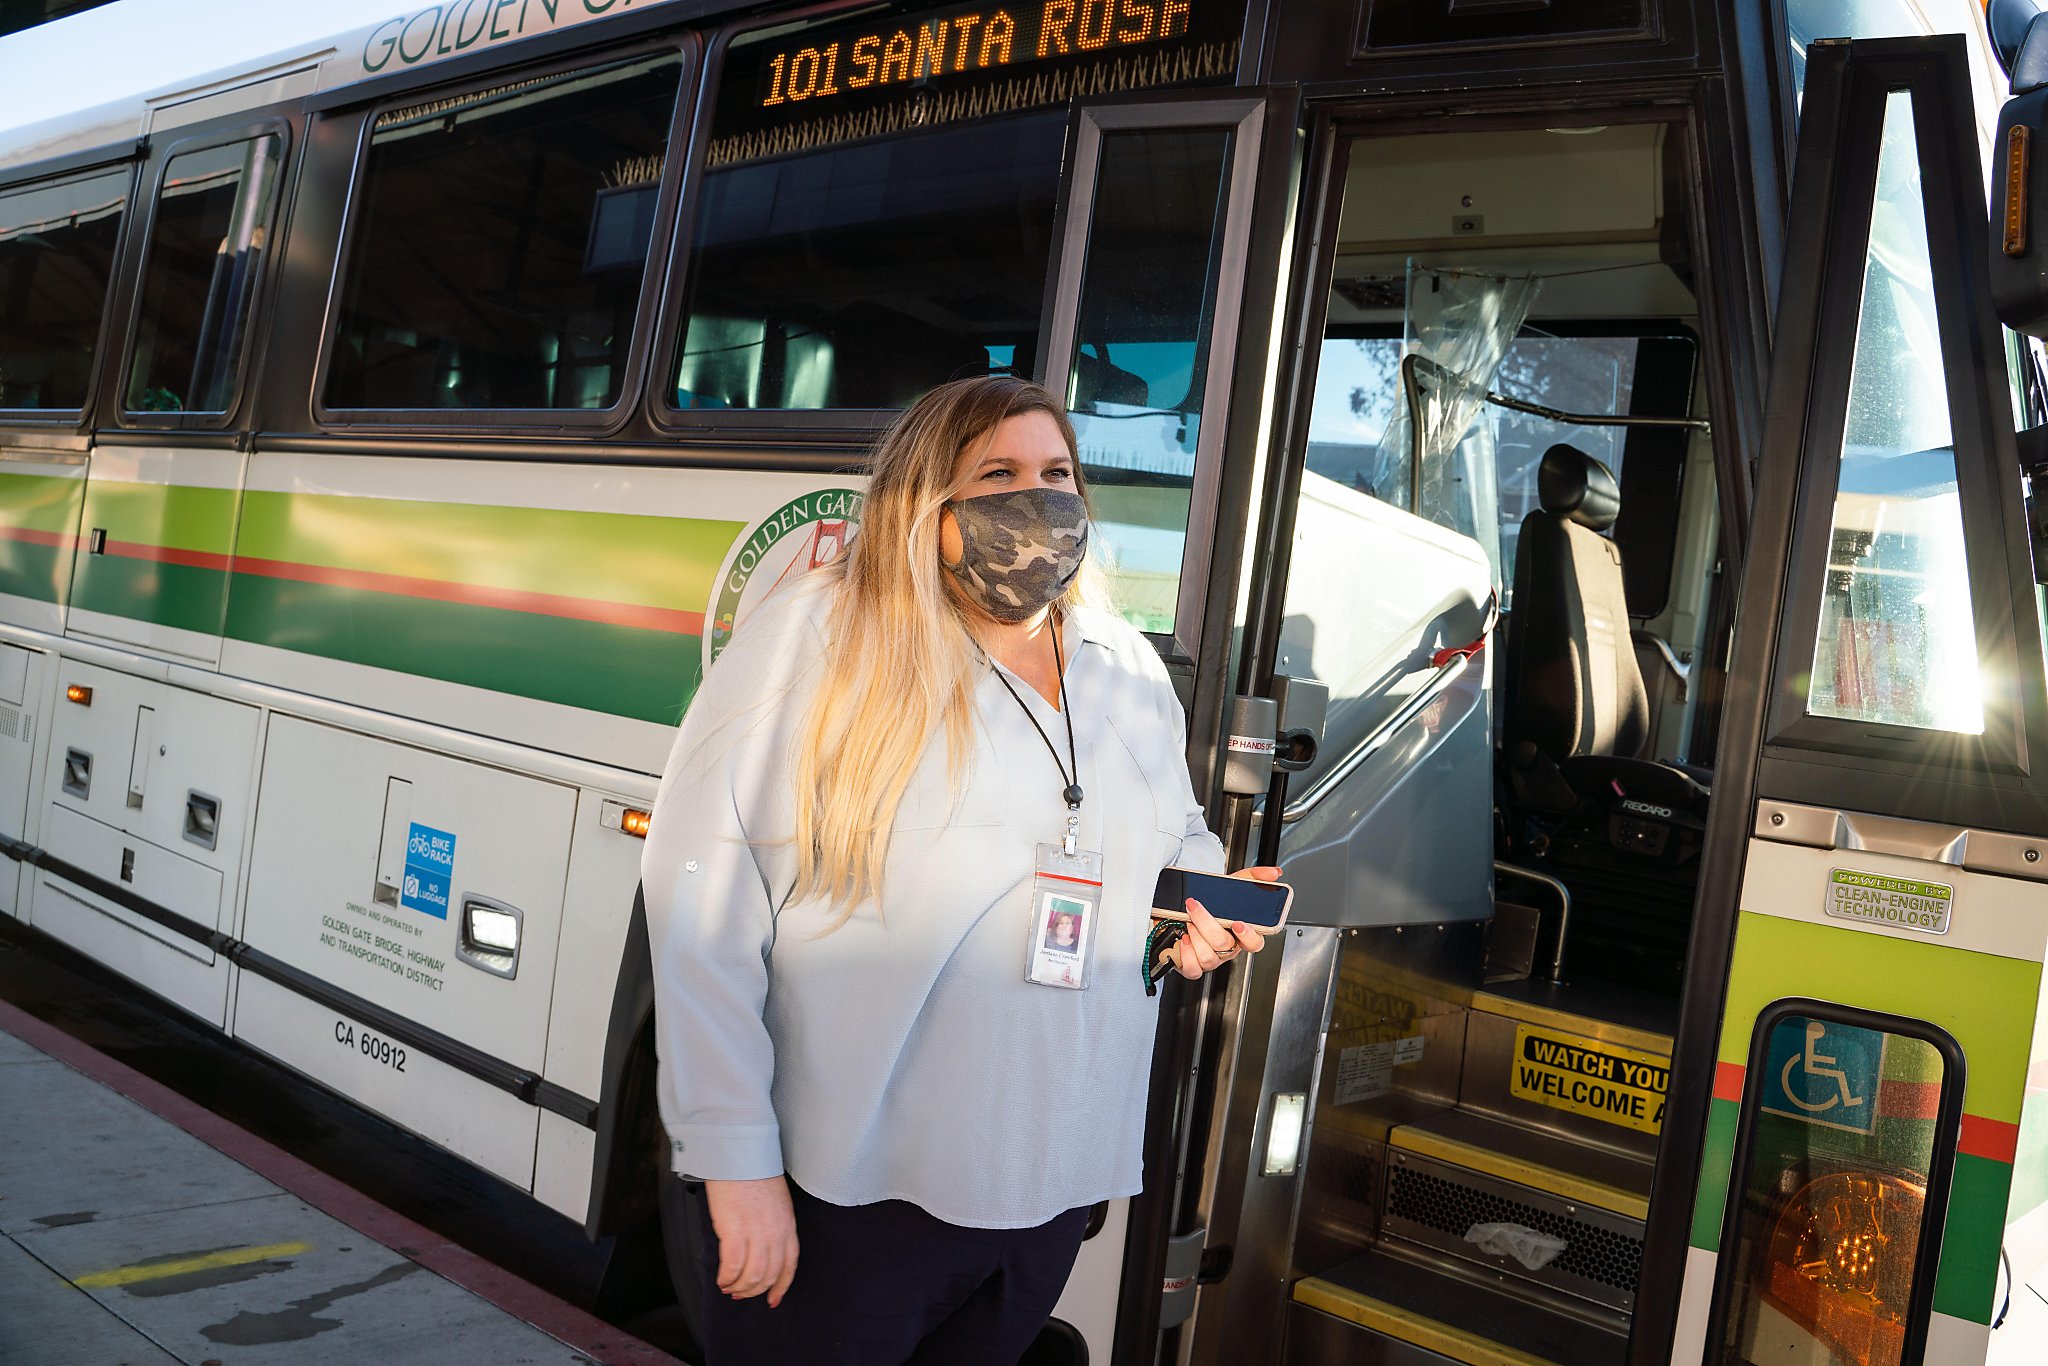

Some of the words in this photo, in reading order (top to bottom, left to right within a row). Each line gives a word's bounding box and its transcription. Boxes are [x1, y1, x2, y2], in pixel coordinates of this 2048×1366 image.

[764, 43, 838, 106] 101
[849, 11, 1015, 88] SANTA
[729, 499, 809, 593] GOLDEN
[1240, 741, 1265, 751] HANDS
[1622, 800, 1672, 817] RECARO
[430, 849, 452, 866] RACK
[431, 837, 450, 852] BIKE
[419, 890, 447, 906] LUGGAGE
[429, 883, 438, 893] NO
[1839, 873, 1917, 891] POWERED
[1925, 886, 1946, 896] BY
[1835, 886, 1944, 914] CLEAN-ENGINE
[1835, 900, 1941, 927] TECHNOLOGY
[346, 901, 367, 916] OWNED
[368, 910, 381, 921] AND
[382, 915, 413, 934] OPERATED
[414, 927, 423, 937] BY
[322, 915, 350, 935] GOLDEN
[352, 927, 372, 944] GATE
[375, 936, 405, 958] BRIDGE,
[407, 949, 446, 973] HIGHWAY
[320, 932, 336, 947] AND
[338, 939, 404, 976] TRANSPORTATION
[406, 967, 444, 992] DISTRICT
[335, 1020, 354, 1048] CA
[361, 1032, 406, 1073] 60912
[1534, 1040, 1614, 1079] WATCH
[1622, 1062, 1669, 1092] YOU
[1520, 1066, 1646, 1119] WELCOME
